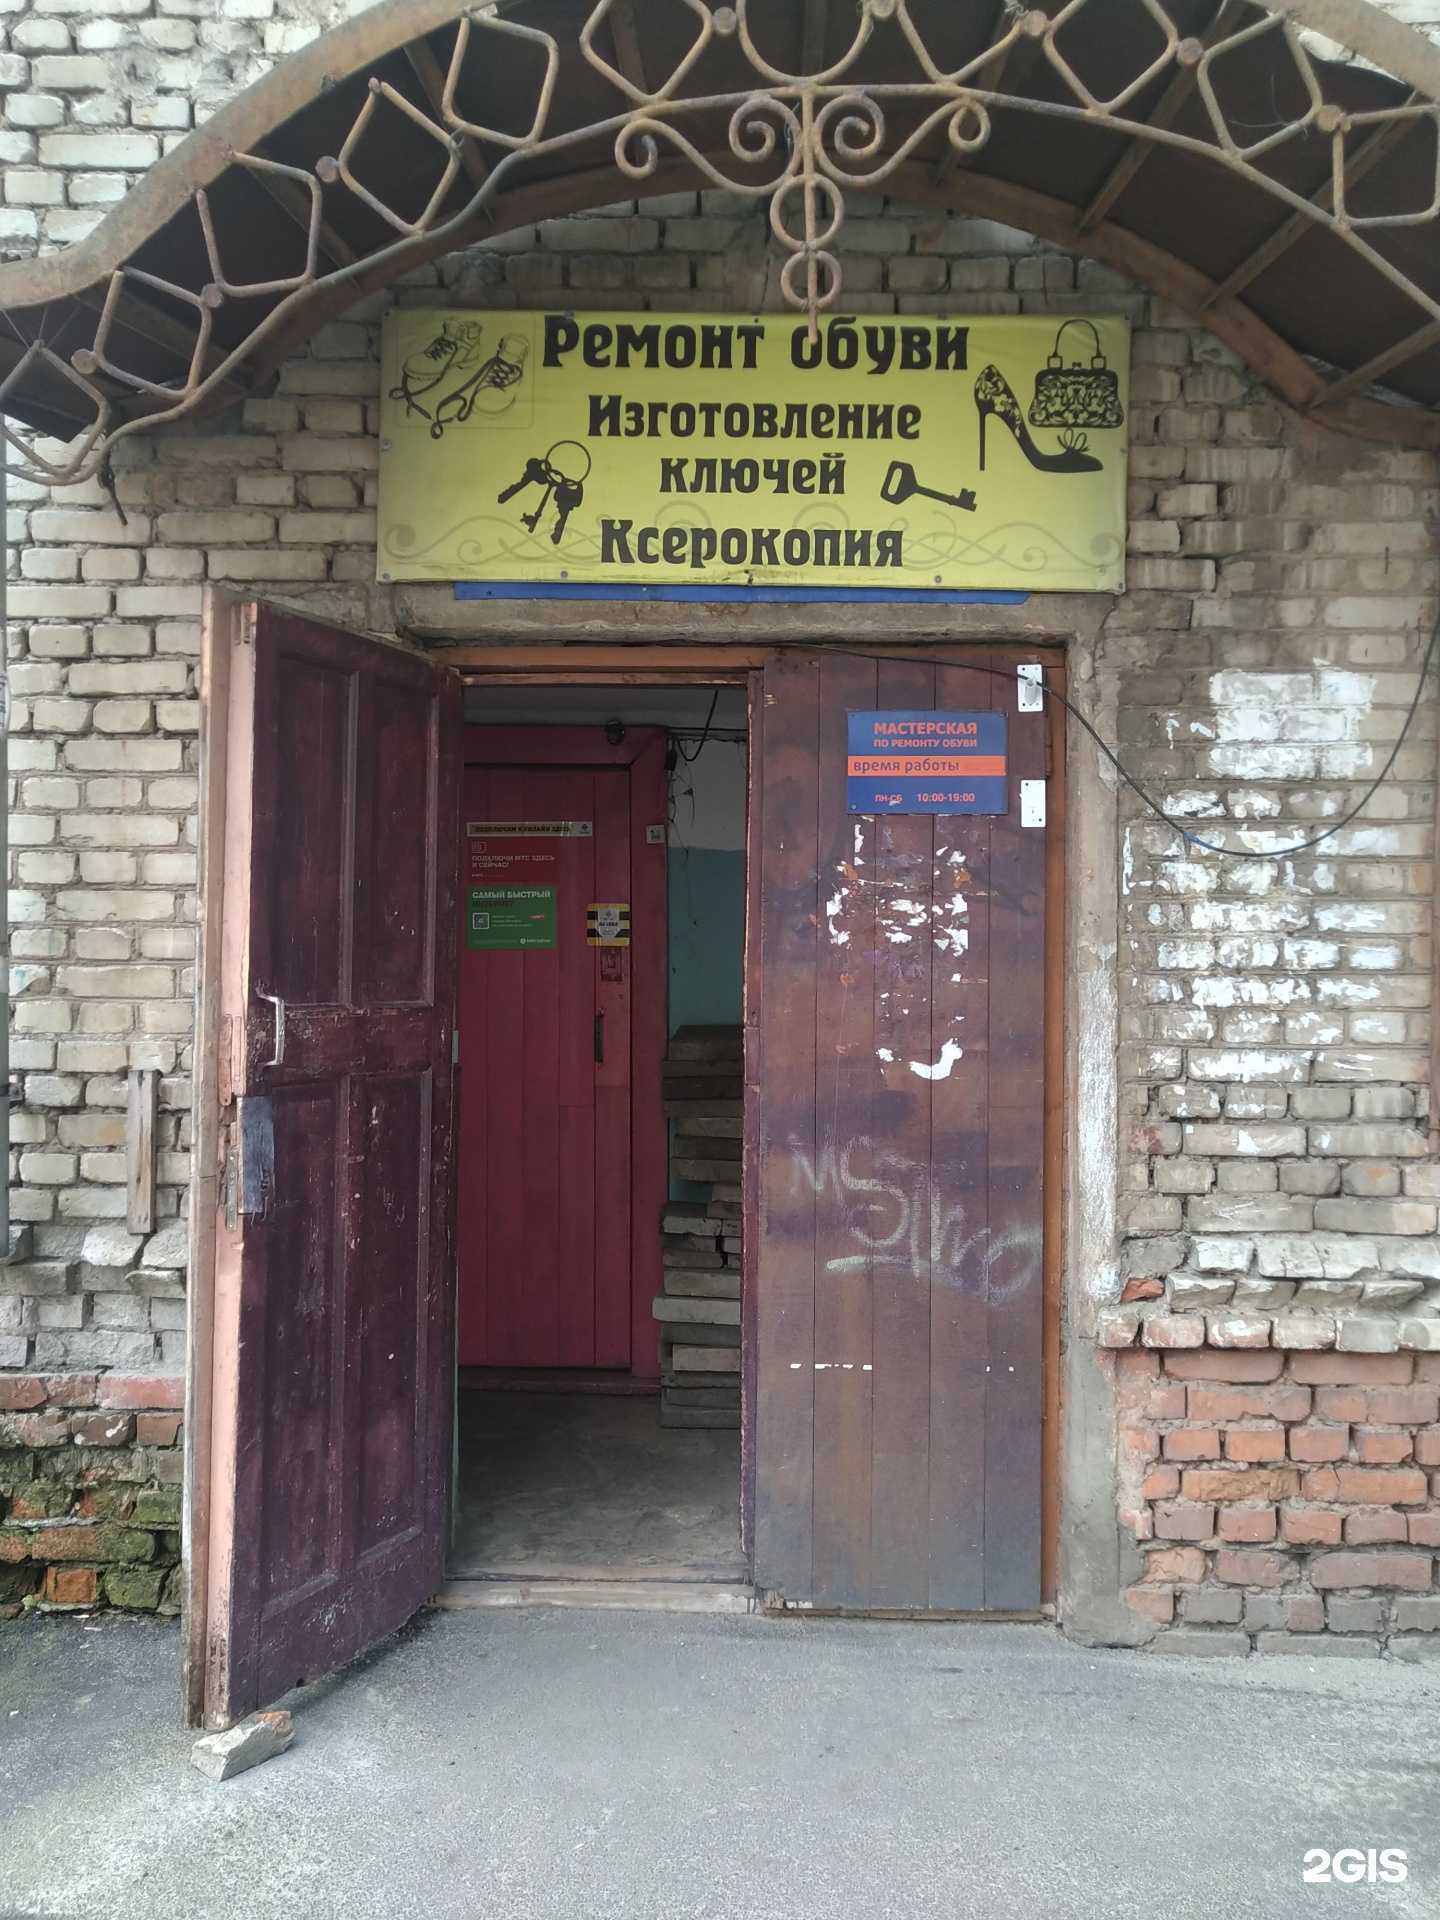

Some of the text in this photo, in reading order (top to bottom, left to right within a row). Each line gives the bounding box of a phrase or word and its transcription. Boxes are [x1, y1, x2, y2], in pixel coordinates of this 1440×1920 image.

[542, 316, 765, 369] Ремонт
[586, 394, 922, 440] Изготовление
[660, 452, 846, 494] ключей
[600, 519, 904, 569] Ксерокопия
[874, 722, 977, 736] МАСТЕРСКАЯ
[874, 739, 977, 748] ПО РЕМОНТУ ОБУВИ
[853, 758, 960, 774] время работы
[917, 792, 976, 802] 10:00-19:00
[472, 890, 551, 899] САМЫЙ БЫСТРЫЙ
